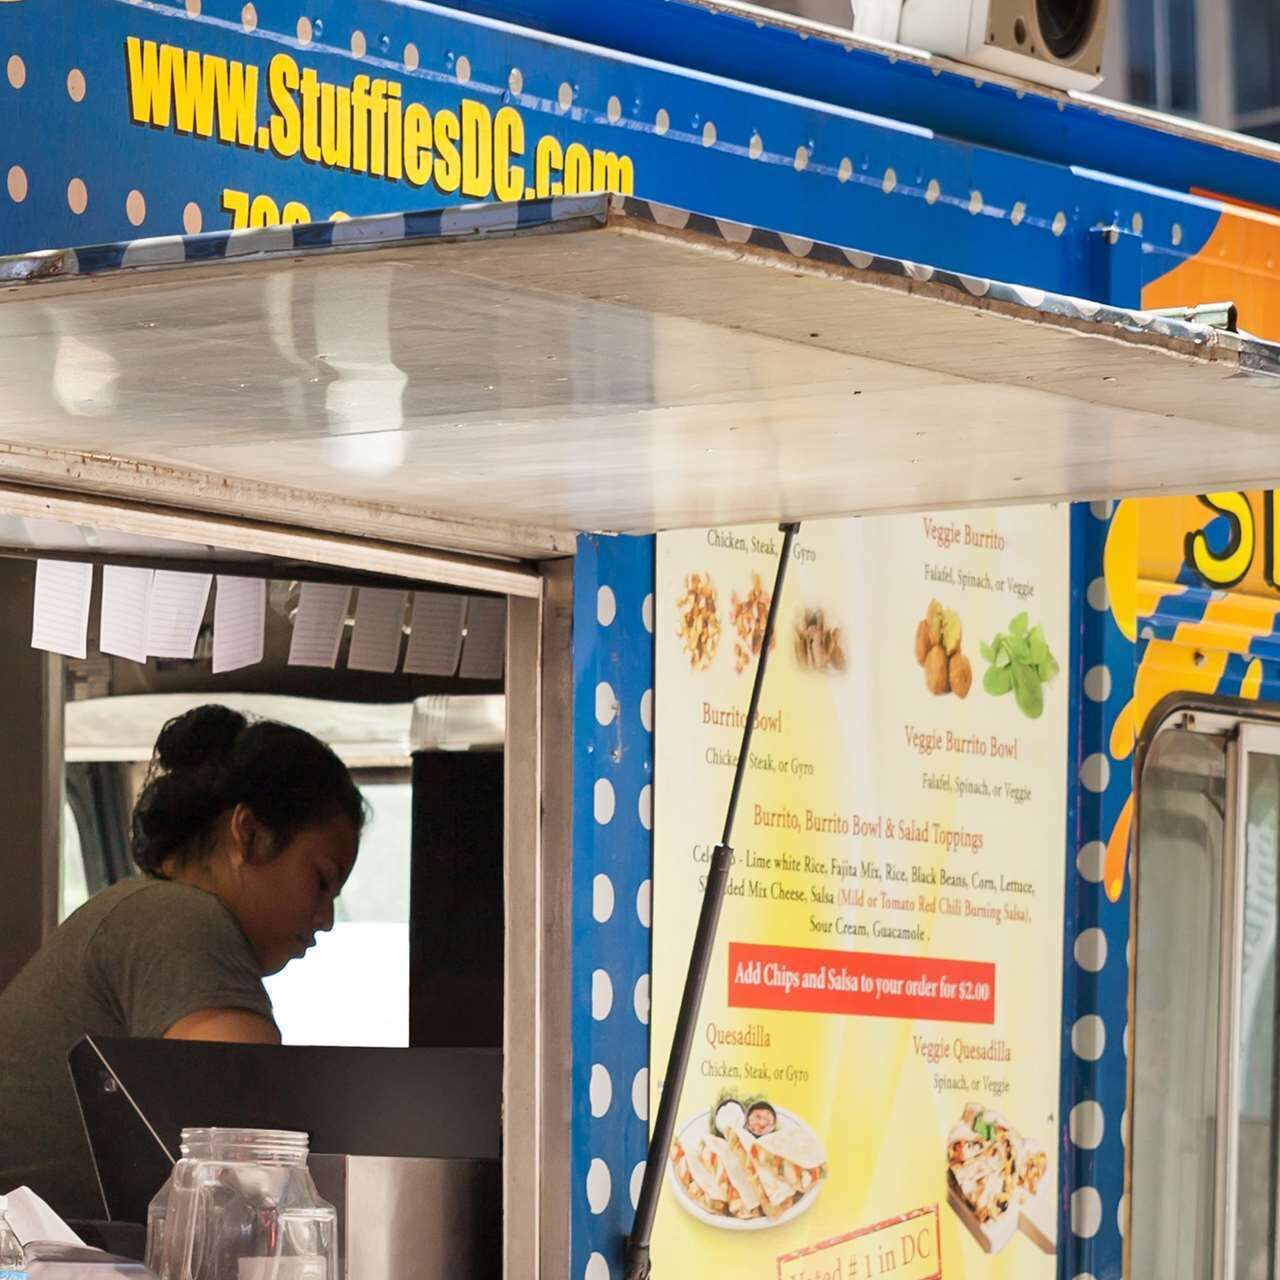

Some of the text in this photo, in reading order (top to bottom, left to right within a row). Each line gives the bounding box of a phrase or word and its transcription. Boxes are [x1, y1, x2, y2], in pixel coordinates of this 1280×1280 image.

[707, 528, 816, 565] Chicken, Steak, Gyro
[923, 517, 1005, 551] Veggie Burrito
[924, 563, 1034, 600] Falafel, Spinach, or Veggie
[905, 725, 1017, 760] Veggie Burrito Bowl
[705, 747, 740, 767] Chicke
[778, 760, 788, 773] or
[791, 758, 815, 779] Gyro
[922, 772, 1032, 805] Falafel, Spinach, or Veggie
[754, 804, 984, 854] Burrito, Burrito Bowl & Salad Toppings
[746, 849, 771, 869] Lime
[774, 853, 801, 872] white
[804, 856, 828, 875] Rice,
[831, 858, 857, 881] Fajita
[860, 861, 882, 881] Mix,
[885, 864, 908, 884] Rice,
[911, 866, 937, 885] Black
[940, 869, 968, 888] Beans,
[971, 872, 998, 892] Corn,
[748, 880, 767, 899] Mix
[811, 885, 834, 905] Salsa
[867, 895, 878, 908] or
[881, 891, 915, 912] Tomato
[918, 895, 936, 914] Red
[965, 900, 1001, 925] Burning
[809, 914, 833, 933] Sour
[835, 917, 870, 937] Cream,
[735, 960, 990, 1001] Add Chips and Salsa to your order for $2.00
[706, 1022, 771, 1049] Quesadilla
[913, 1035, 1011, 1064] Veggie Quesadilla
[701, 1059, 809, 1087] Chicken, Steak, or Gyro
[971, 1079, 981, 1091] or
[983, 1075, 1009, 1097] Veggie
[865, 1254, 873, 1279] 1
[879, 1244, 896, 1275] in
[901, 1228, 931, 1266] DC
